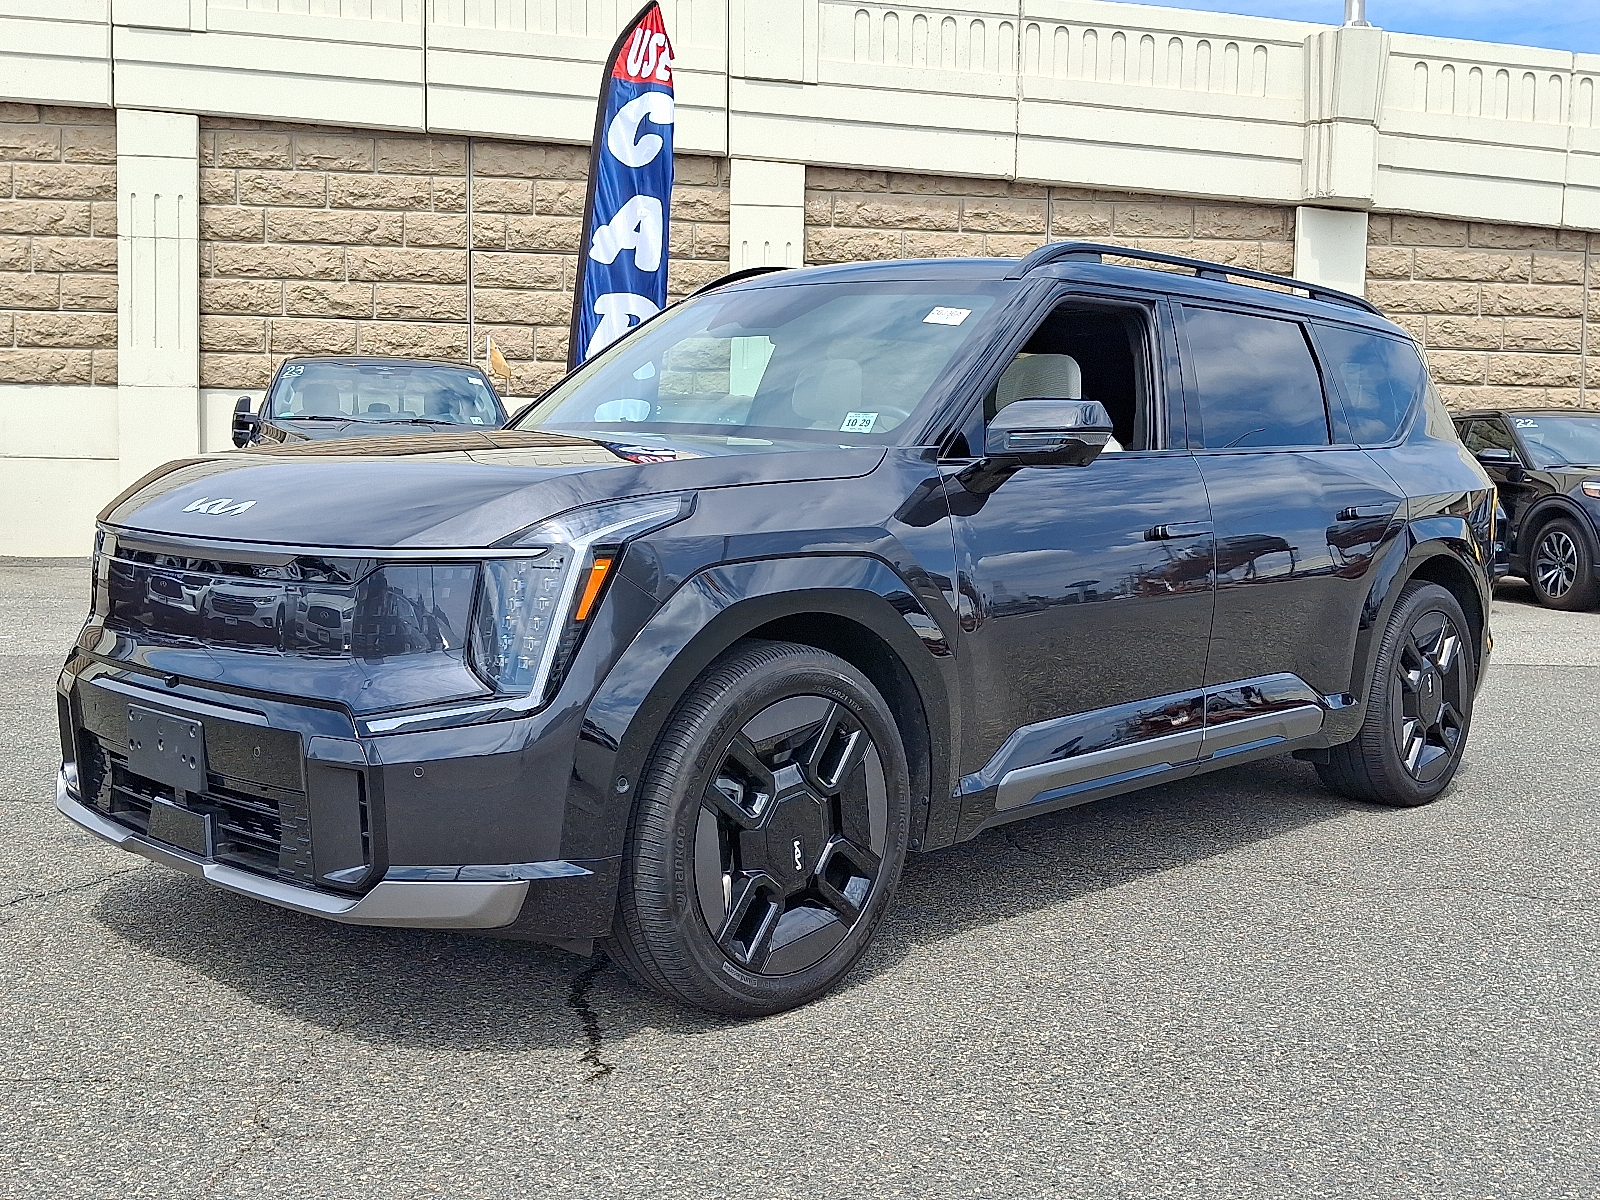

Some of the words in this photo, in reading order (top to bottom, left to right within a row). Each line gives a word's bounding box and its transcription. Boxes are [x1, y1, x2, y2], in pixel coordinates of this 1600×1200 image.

[281, 365, 305, 378] 23
[845, 418, 858, 427] 10
[858, 418, 871, 428] 29
[1515, 418, 1539, 429] 22
[182, 496, 257, 516] KIA
